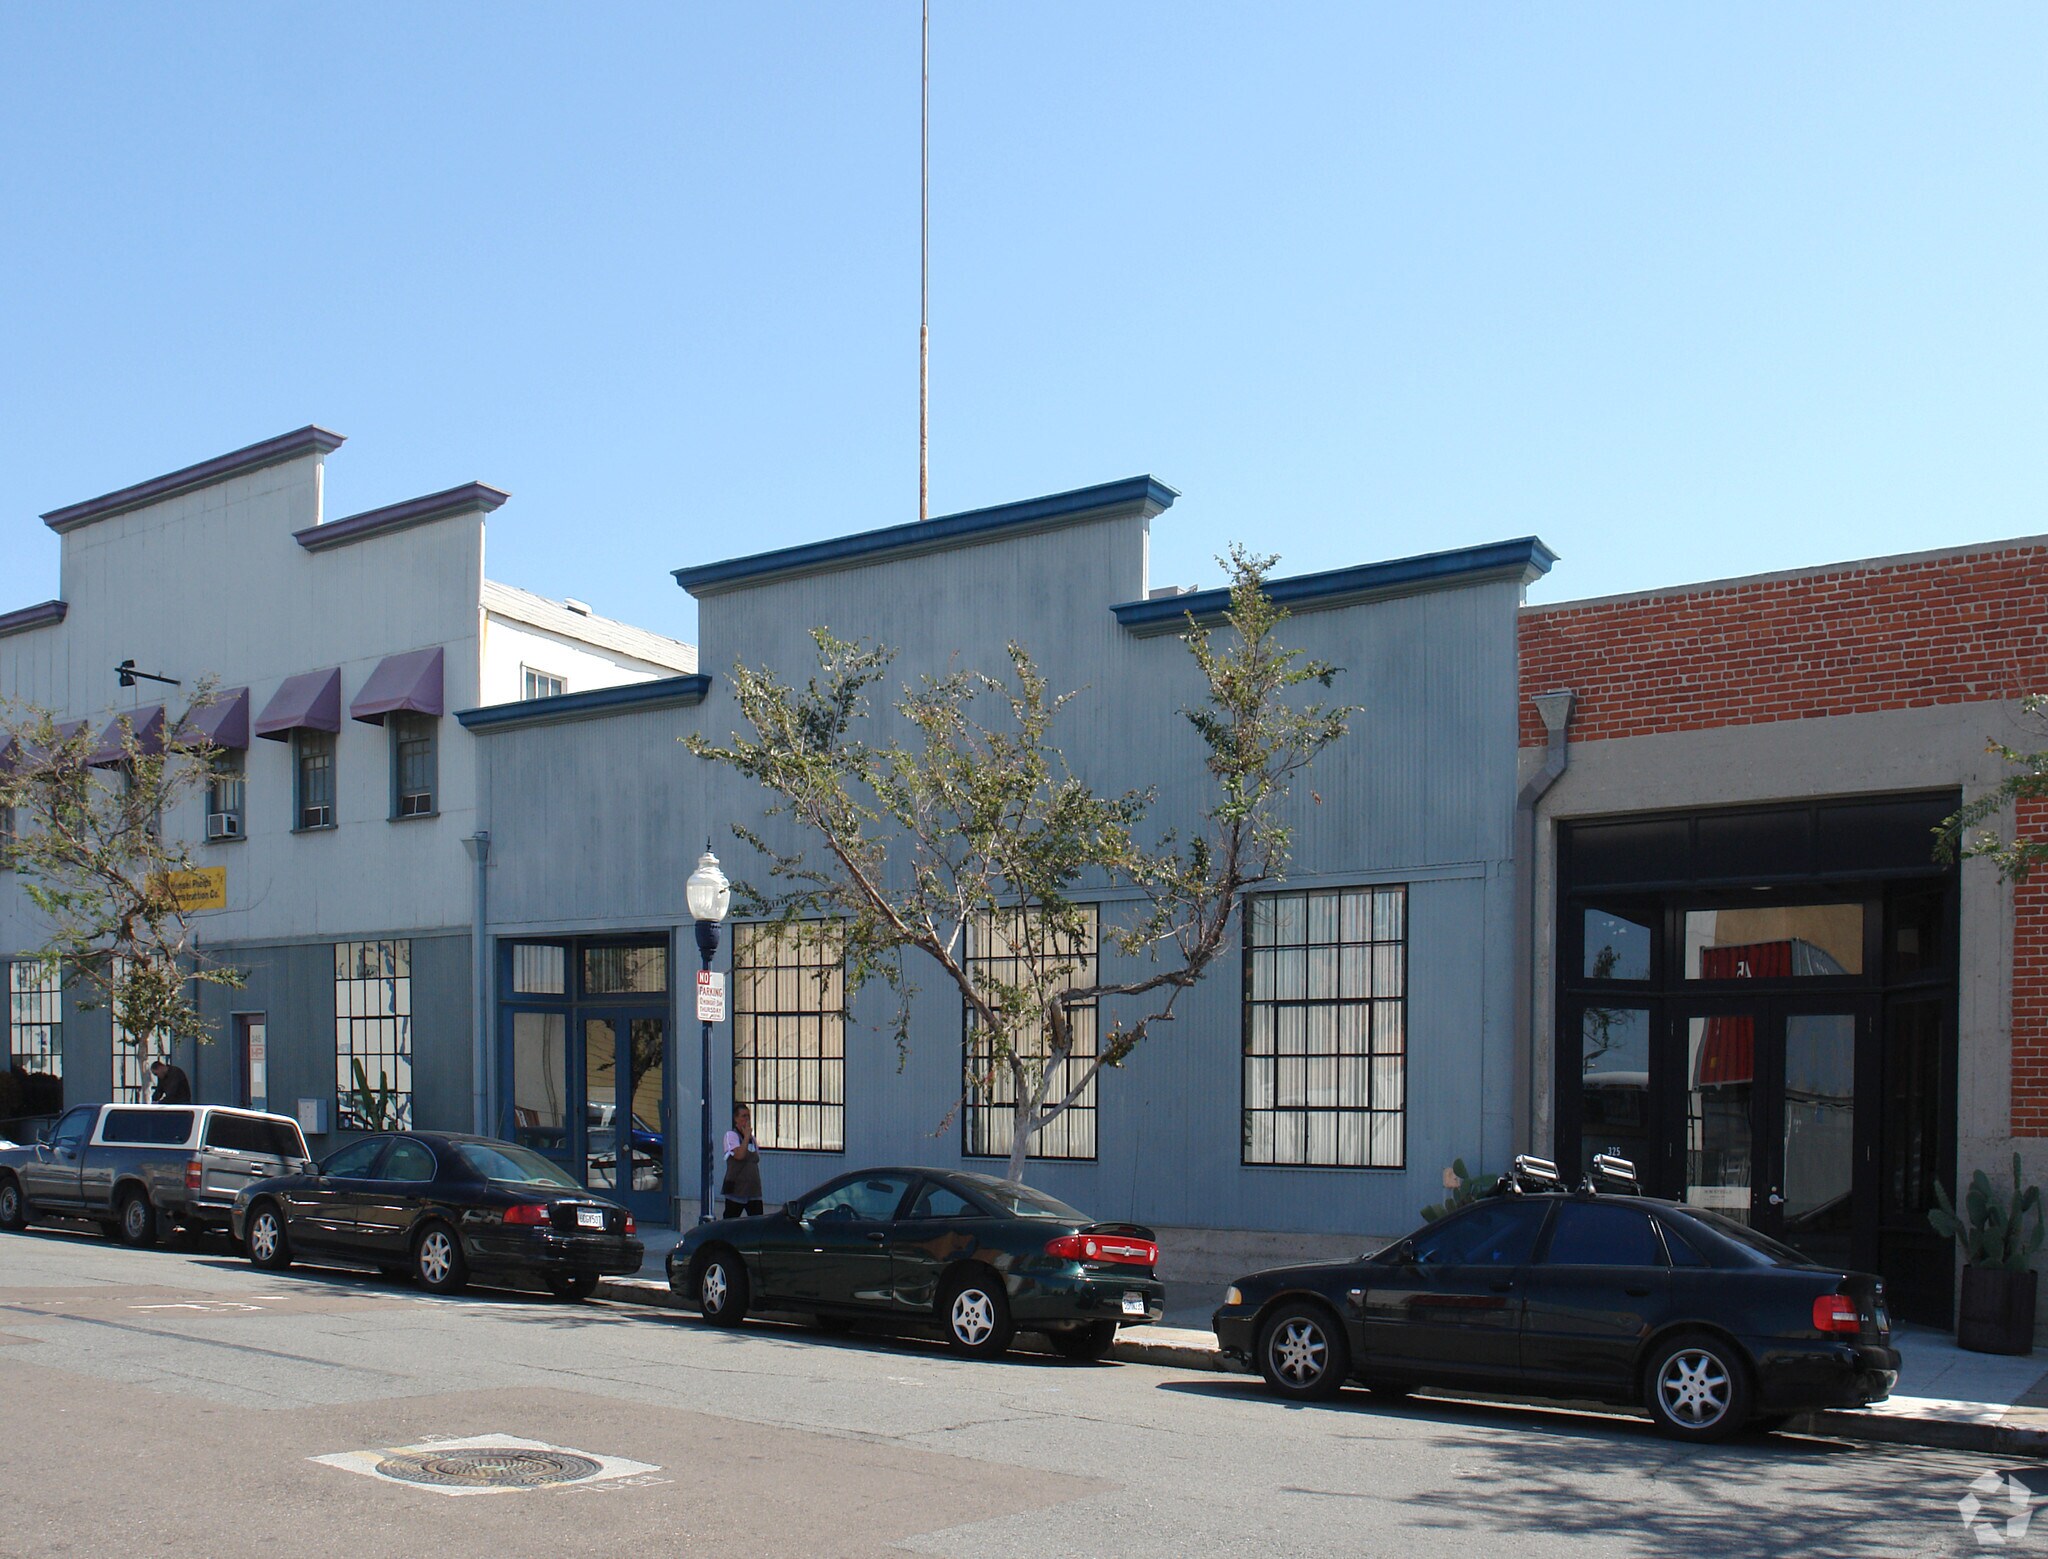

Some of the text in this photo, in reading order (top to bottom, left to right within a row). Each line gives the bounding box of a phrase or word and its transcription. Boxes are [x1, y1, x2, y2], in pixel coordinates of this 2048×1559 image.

[699, 972, 709, 983] NO
[700, 986, 722, 998] PARKING
[1607, 1146, 1621, 1156] 325
